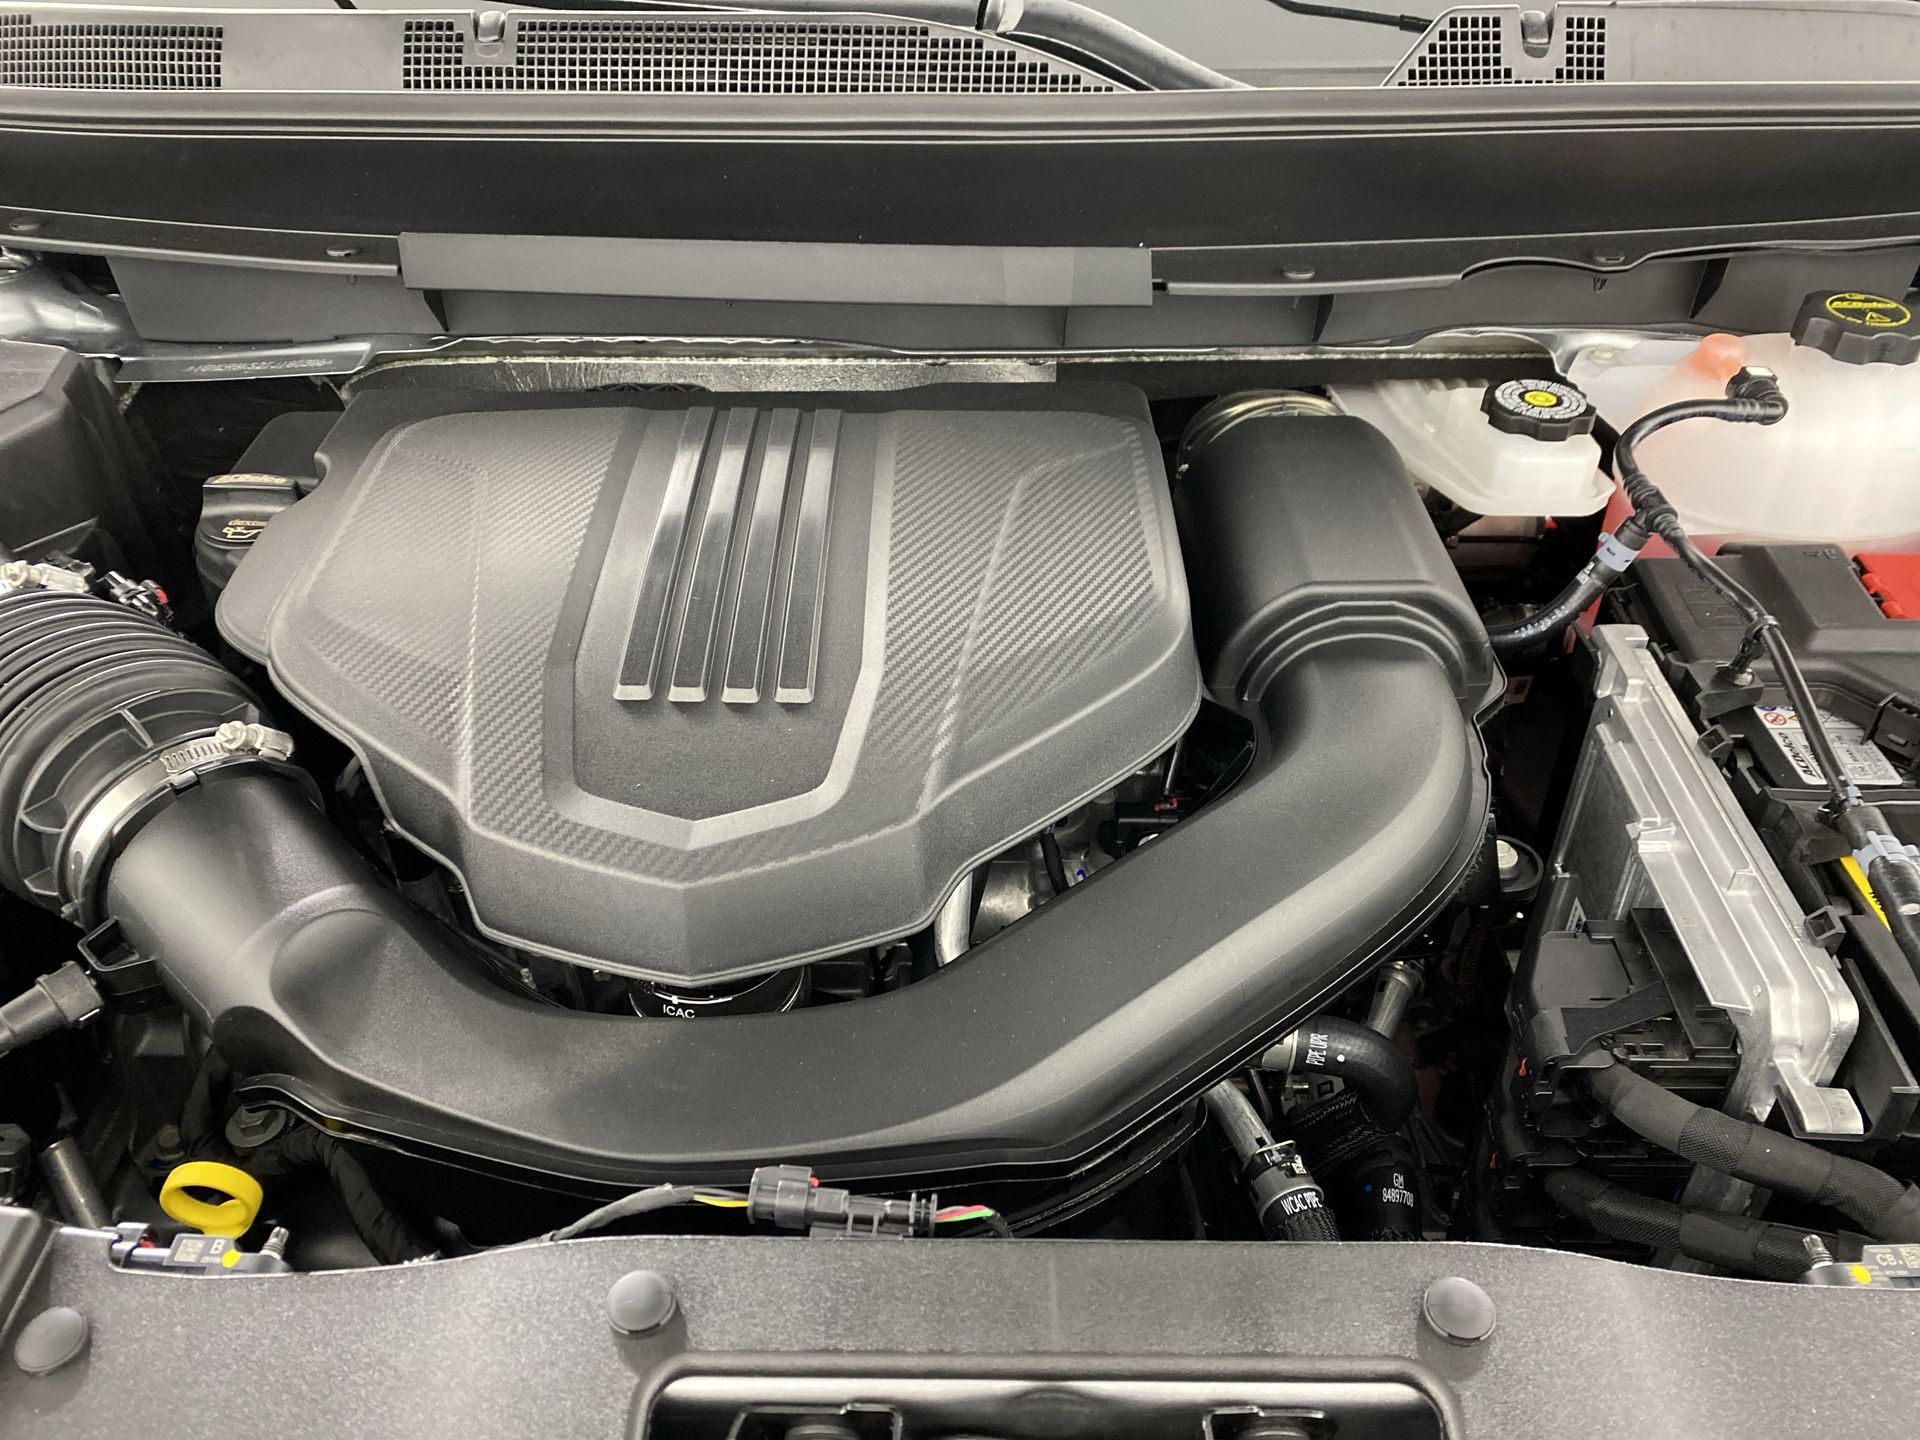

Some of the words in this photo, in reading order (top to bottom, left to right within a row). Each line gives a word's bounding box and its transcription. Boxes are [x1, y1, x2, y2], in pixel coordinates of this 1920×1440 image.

[1778, 732, 1817, 778] ACDelco
[663, 1004, 695, 1019] ICAC
[1309, 1033, 1328, 1049] UPR
[1393, 1172, 1405, 1189] GM
[1280, 1193, 1308, 1216] WCAC
[209, 1238, 226, 1254] B
